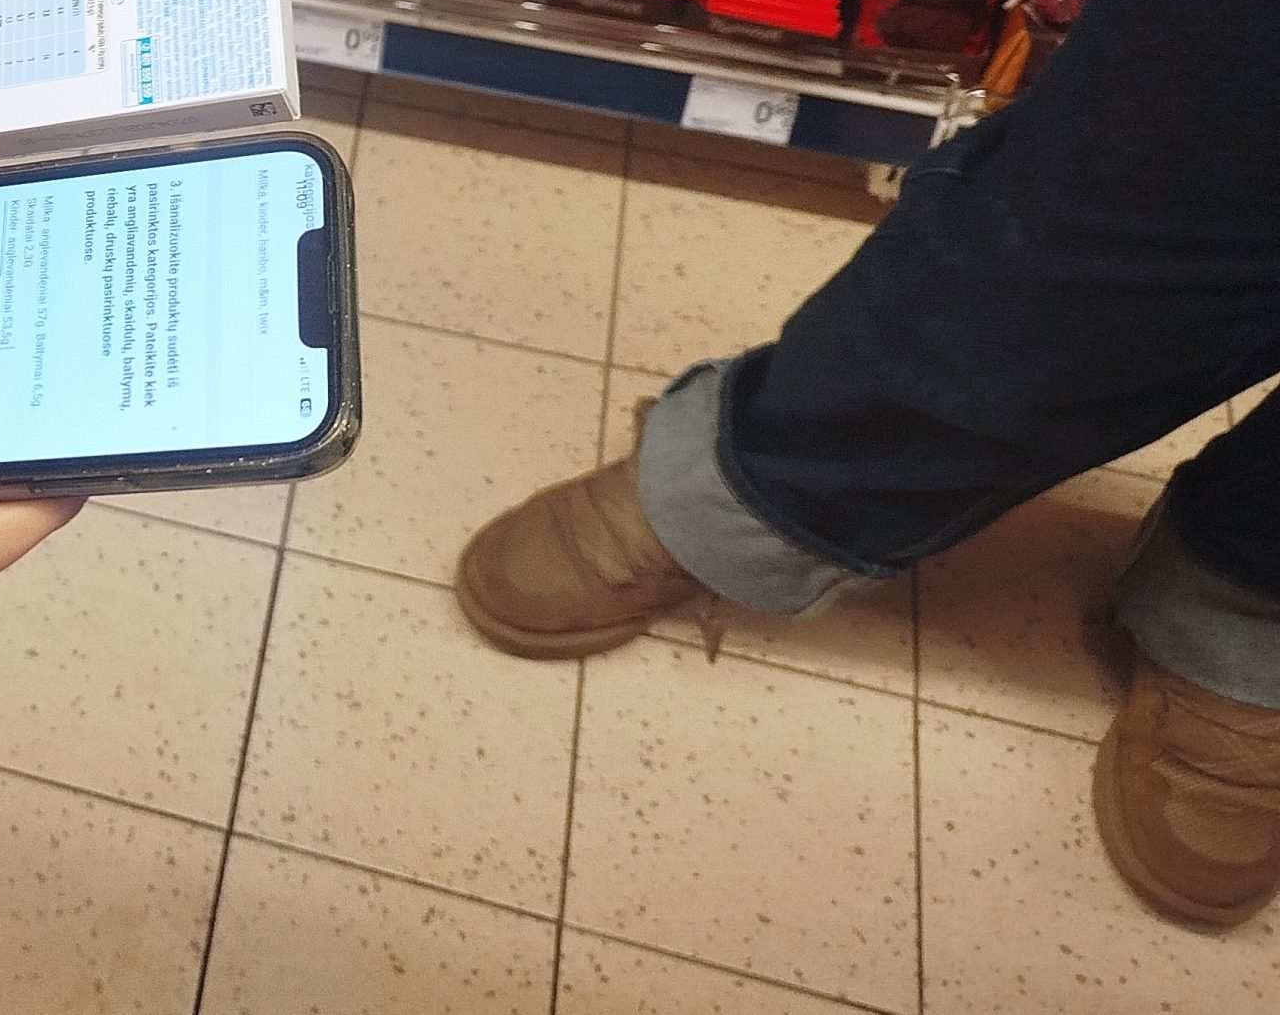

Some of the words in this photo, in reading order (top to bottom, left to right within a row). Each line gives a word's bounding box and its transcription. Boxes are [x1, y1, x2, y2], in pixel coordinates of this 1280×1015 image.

[125, 185, 137, 203] yra
[170, 180, 182, 191] 3.
[257, 169, 269, 200] Milka,
[296, 179, 307, 209] 11:09
[302, 164, 318, 230] kategorijos
[84, 190, 97, 264] produktuose.
[104, 188, 118, 230] riebalų,
[146, 183, 160, 246] pasirinktos
[257, 202, 269, 235] kinder,
[102, 232, 117, 272] druskų
[122, 206, 138, 296] angliavandenių,
[168, 194, 182, 275] Išanalizuokite
[256, 239, 269, 275] haribo,
[2, 237, 16, 313] anglevandeniai
[38, 228, 51, 305] anglevandeniai
[143, 249, 159, 319] kategorijos.
[101, 275, 116, 357] pasirinktuose
[120, 300, 136, 354] skaidulų,
[166, 278, 181, 332] produktų
[259, 313, 269, 335] twix
[32, 333, 46, 381] Baltymai
[145, 322, 158, 378] Pateikite
[167, 335, 180, 373] sudėti
[119, 356, 136, 411] baltymų,
[144, 381, 157, 407] kiek
[167, 377, 180, 388] iš
[300, 377, 310, 393] LTE
